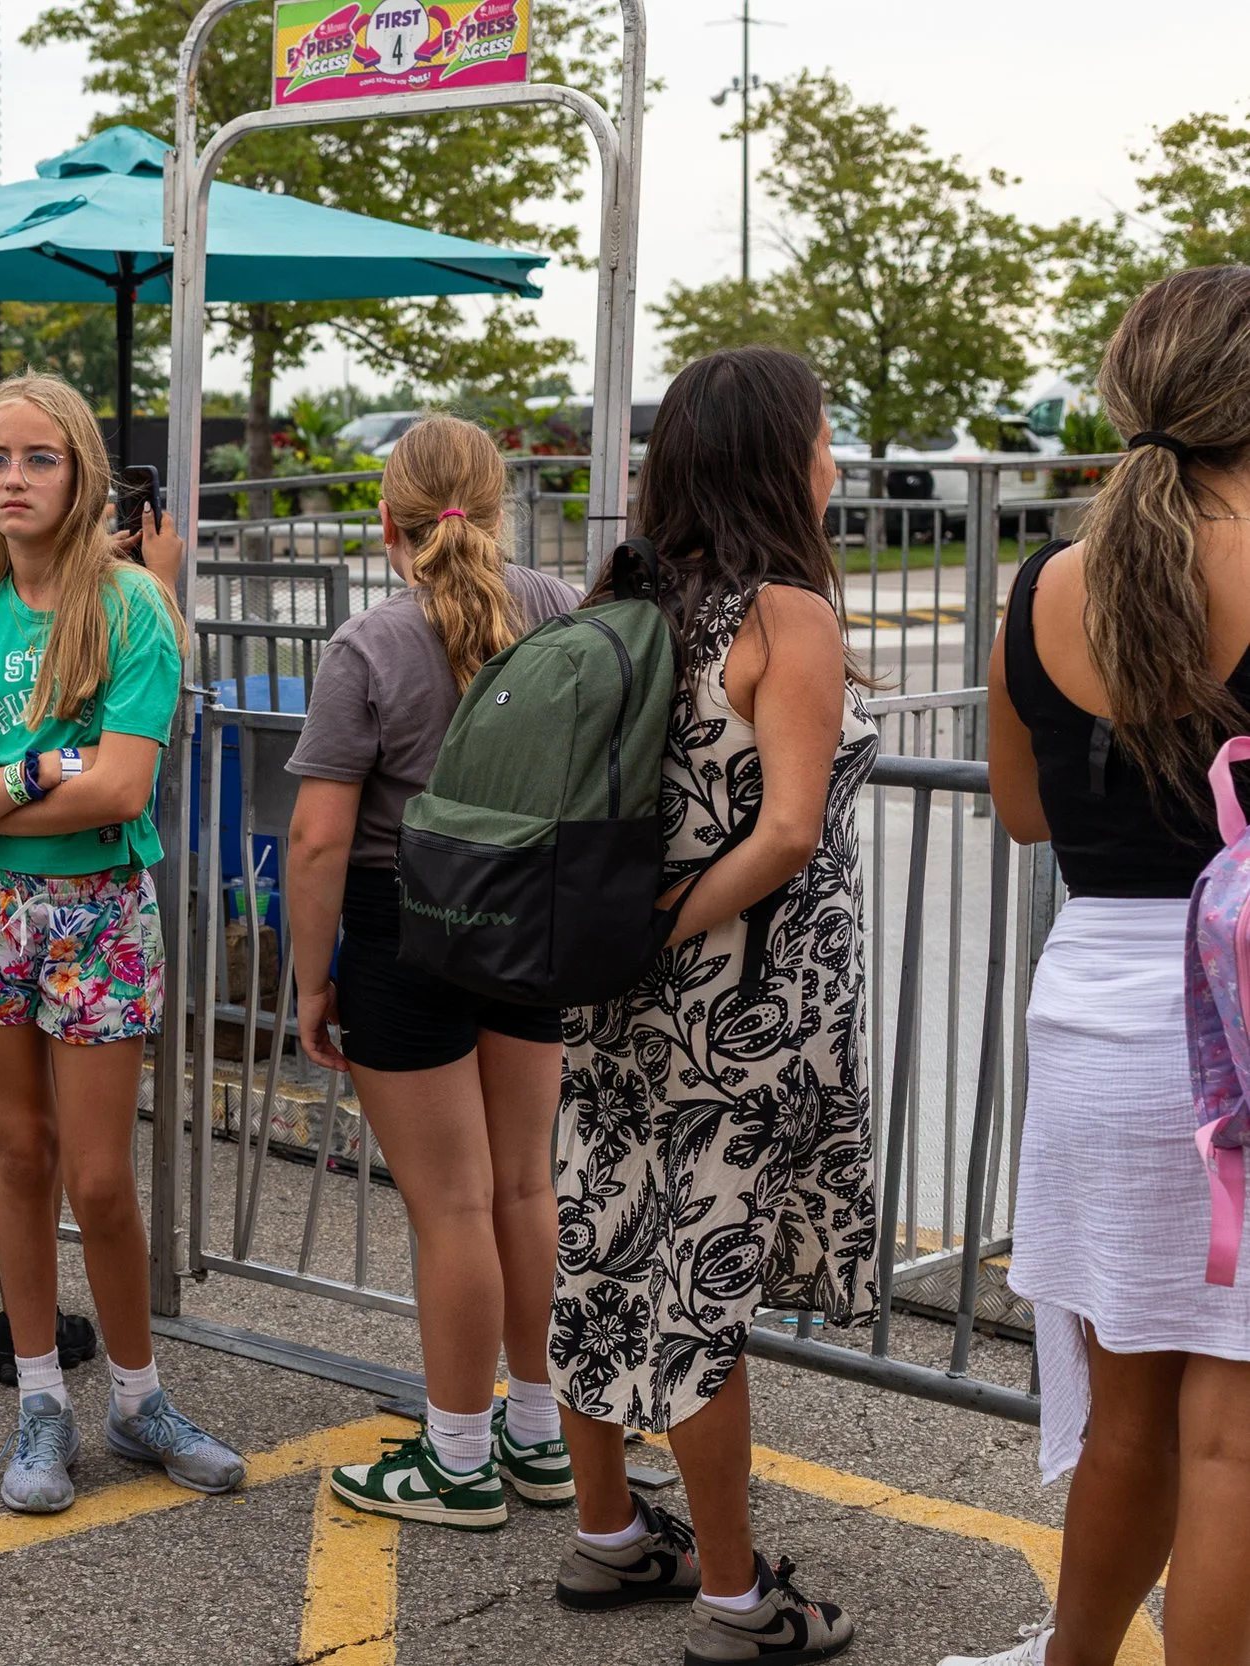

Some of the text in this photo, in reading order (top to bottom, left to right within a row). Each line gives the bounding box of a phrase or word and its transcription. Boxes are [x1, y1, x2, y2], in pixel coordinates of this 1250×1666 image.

[376, 9, 421, 30] FIRST
[444, 14, 518, 52] EXPRESS
[287, 33, 354, 70] EXPRESS
[392, 34, 403, 66] 4
[460, 36, 512, 62] ACCESS
[302, 53, 350, 78] ACCESS
[399, 883, 517, 936] hampion
[546, 1442, 564, 1455] NIKE
